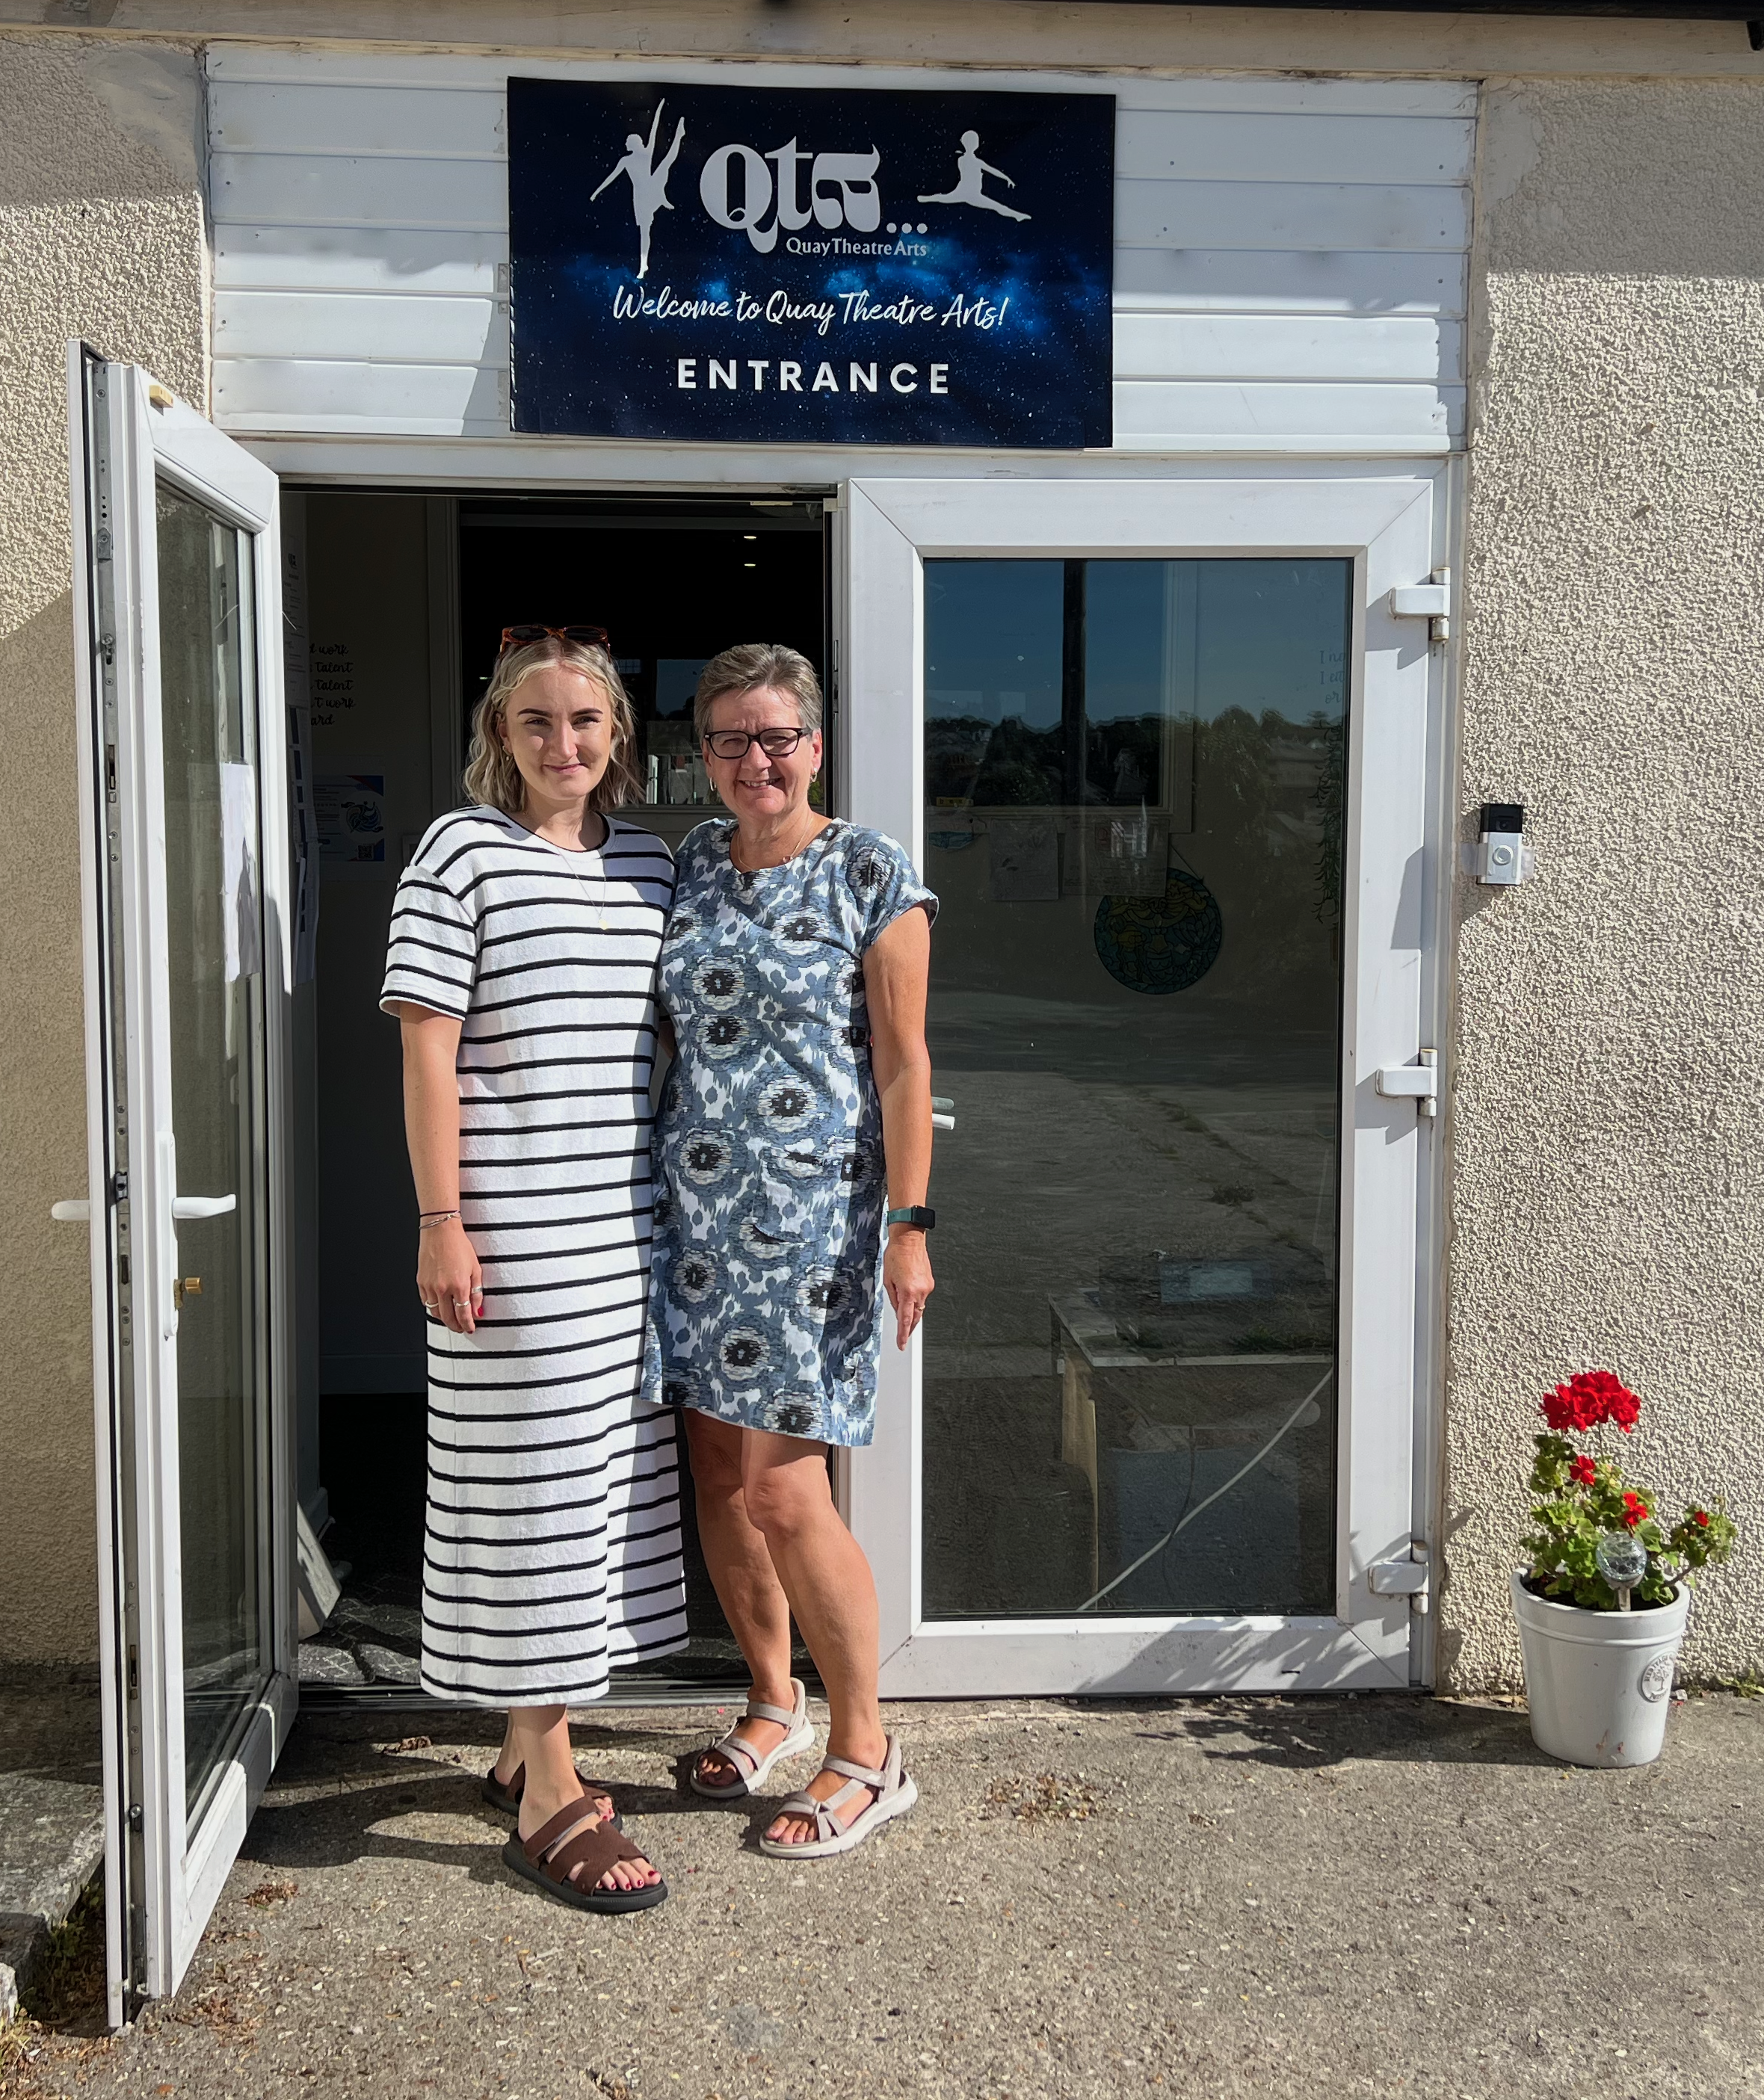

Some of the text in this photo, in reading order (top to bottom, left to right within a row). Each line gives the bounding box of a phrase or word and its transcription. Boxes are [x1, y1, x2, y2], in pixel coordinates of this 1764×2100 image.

[893, 240, 927, 256] Arts
[613, 285, 1011, 336] Welcome to Quay Theatre Arts!
[678, 358, 949, 394] ENTRANCE
[318, 643, 349, 656] work
[315, 679, 354, 691] talent
[325, 697, 357, 710] work
[310, 713, 335, 726] ard
